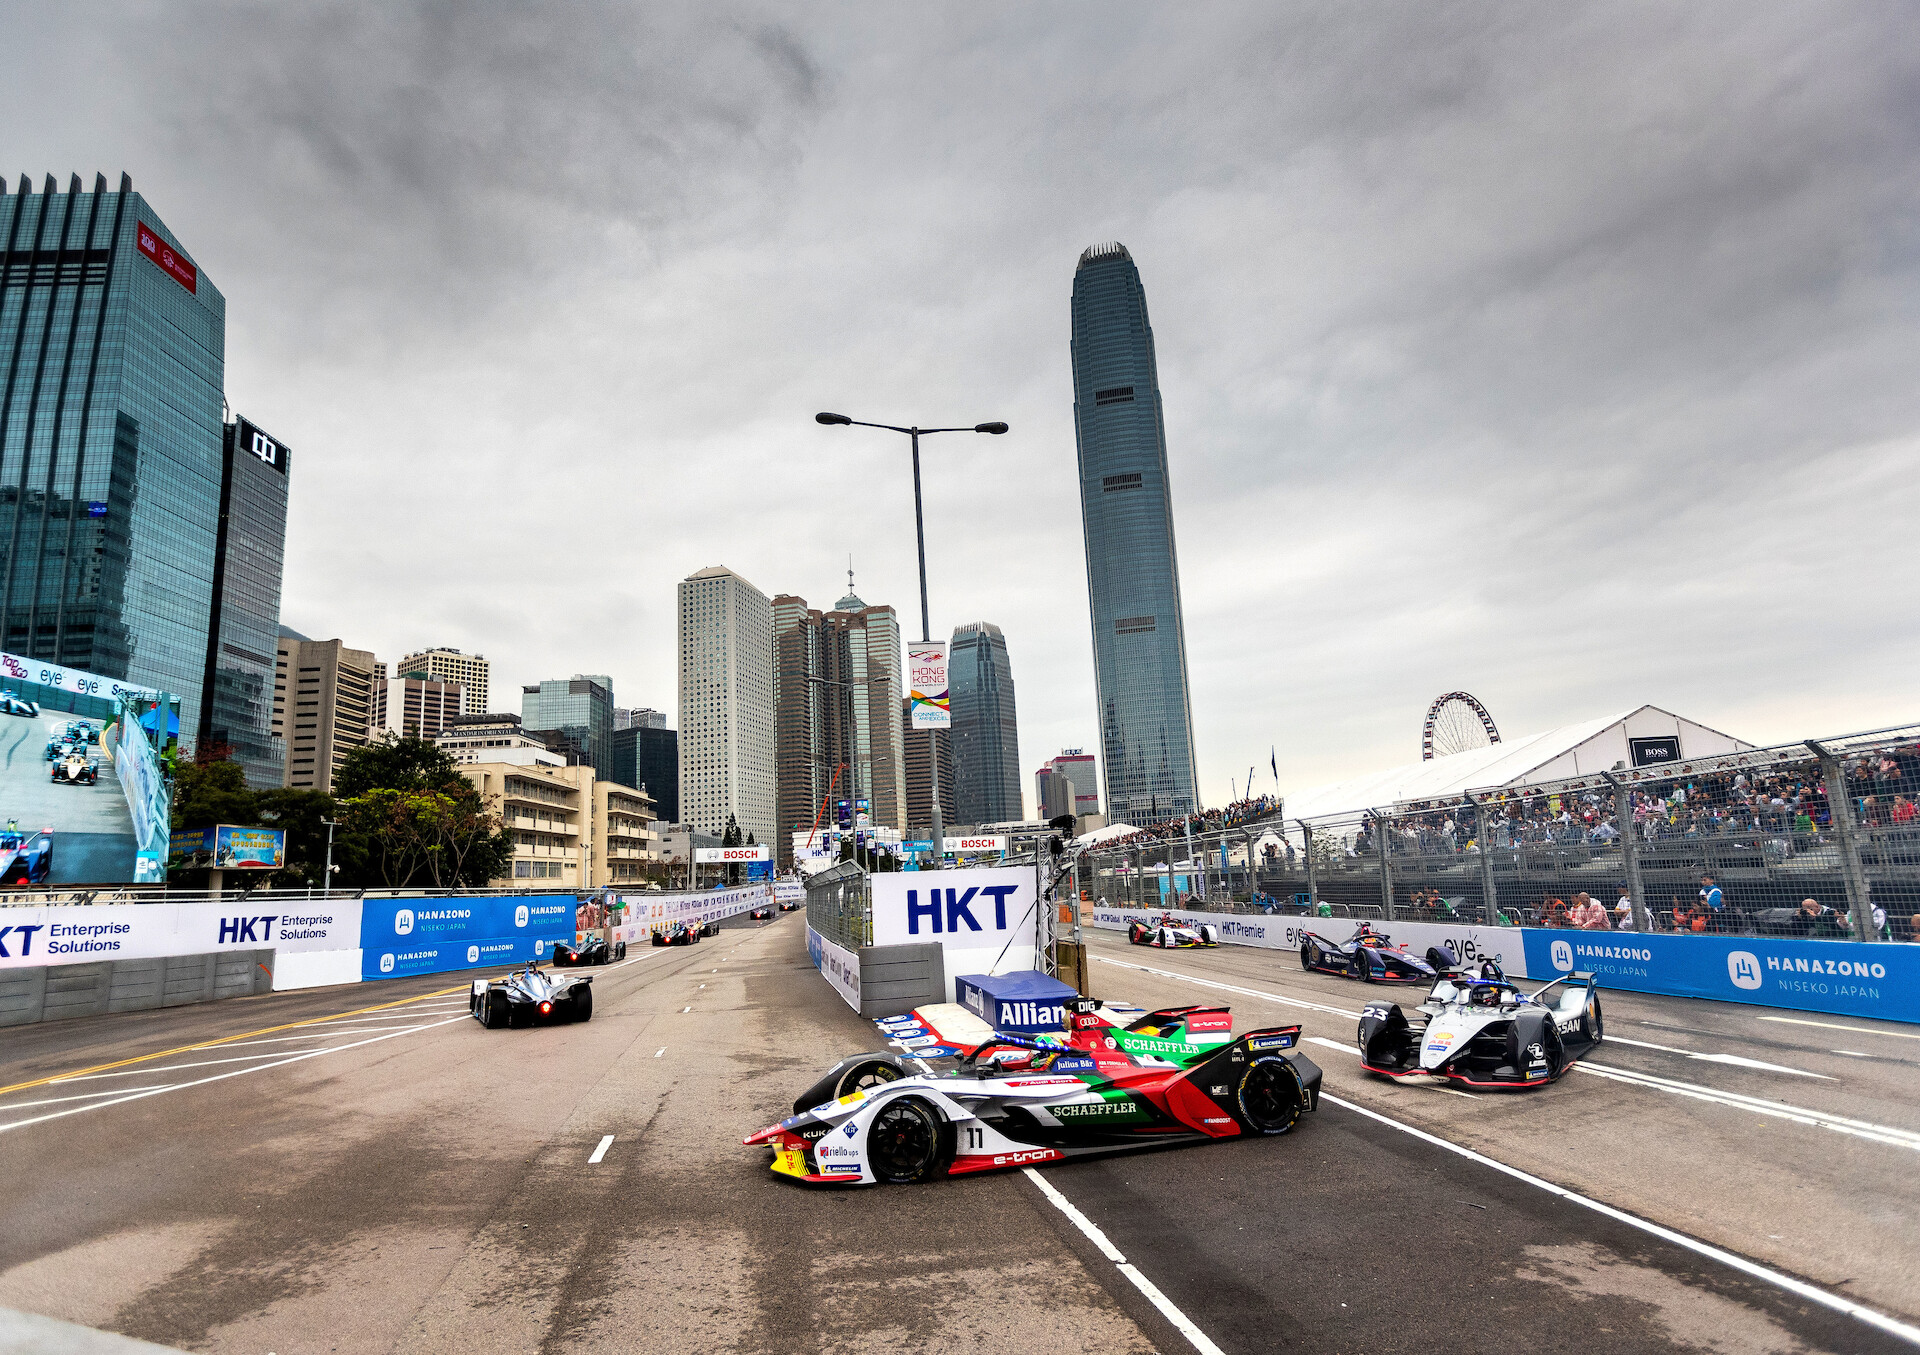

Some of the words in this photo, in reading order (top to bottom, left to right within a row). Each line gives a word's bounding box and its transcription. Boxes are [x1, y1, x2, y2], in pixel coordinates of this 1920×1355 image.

[2, 655, 20, 671] Tap
[40, 670, 62, 686] eye
[912, 667, 944, 675] HONG
[78, 678, 98, 694] eye
[912, 676, 944, 684] KONG
[1645, 748, 1668, 756] BOSS
[962, 839, 994, 848] BOSCH
[724, 850, 758, 859] BOSCH
[418, 909, 471, 920] HANAZONO
[531, 906, 566, 914] HANAZONO
[907, 885, 1019, 934] HKT
[218, 916, 279, 943] HKT
[282, 914, 333, 927] Enterprise
[280, 928, 327, 940] Solutions
[1222, 921, 1236, 935] HKT
[1237, 923, 1265, 938] Premier
[0, 925, 44, 957] KT
[50, 922, 130, 938] Enterprise
[1286, 927, 1304, 947] eye
[48, 940, 121, 954] Solutions
[481, 944, 514, 952] HANAZONO
[1444, 938, 1476, 965] eye
[1576, 944, 1651, 961] HANAZONO
[398, 950, 438, 960] HANAZONO
[1584, 963, 1616, 974] NISEKO
[1618, 966, 1648, 977] JAPAN
[1766, 956, 1886, 978] HANAZONO
[1778, 980, 1828, 994] NISEKO
[1834, 984, 1879, 999] JAPAN
[1001, 1002, 1066, 1025] Allian
[1078, 1001, 1096, 1012] DIG
[1362, 1006, 1388, 1021] 23
[1556, 1018, 1581, 1034] SSAN
[1124, 1038, 1200, 1054] SCHAEFFLER
[1057, 1059, 1079, 1070] Julius
[1080, 1058, 1093, 1068] Bär
[1054, 1102, 1136, 1117] SCHAEFFLER
[967, 1128, 983, 1148] 11
[830, 1147, 848, 1156] riello
[994, 1149, 1055, 1165] e-tron
